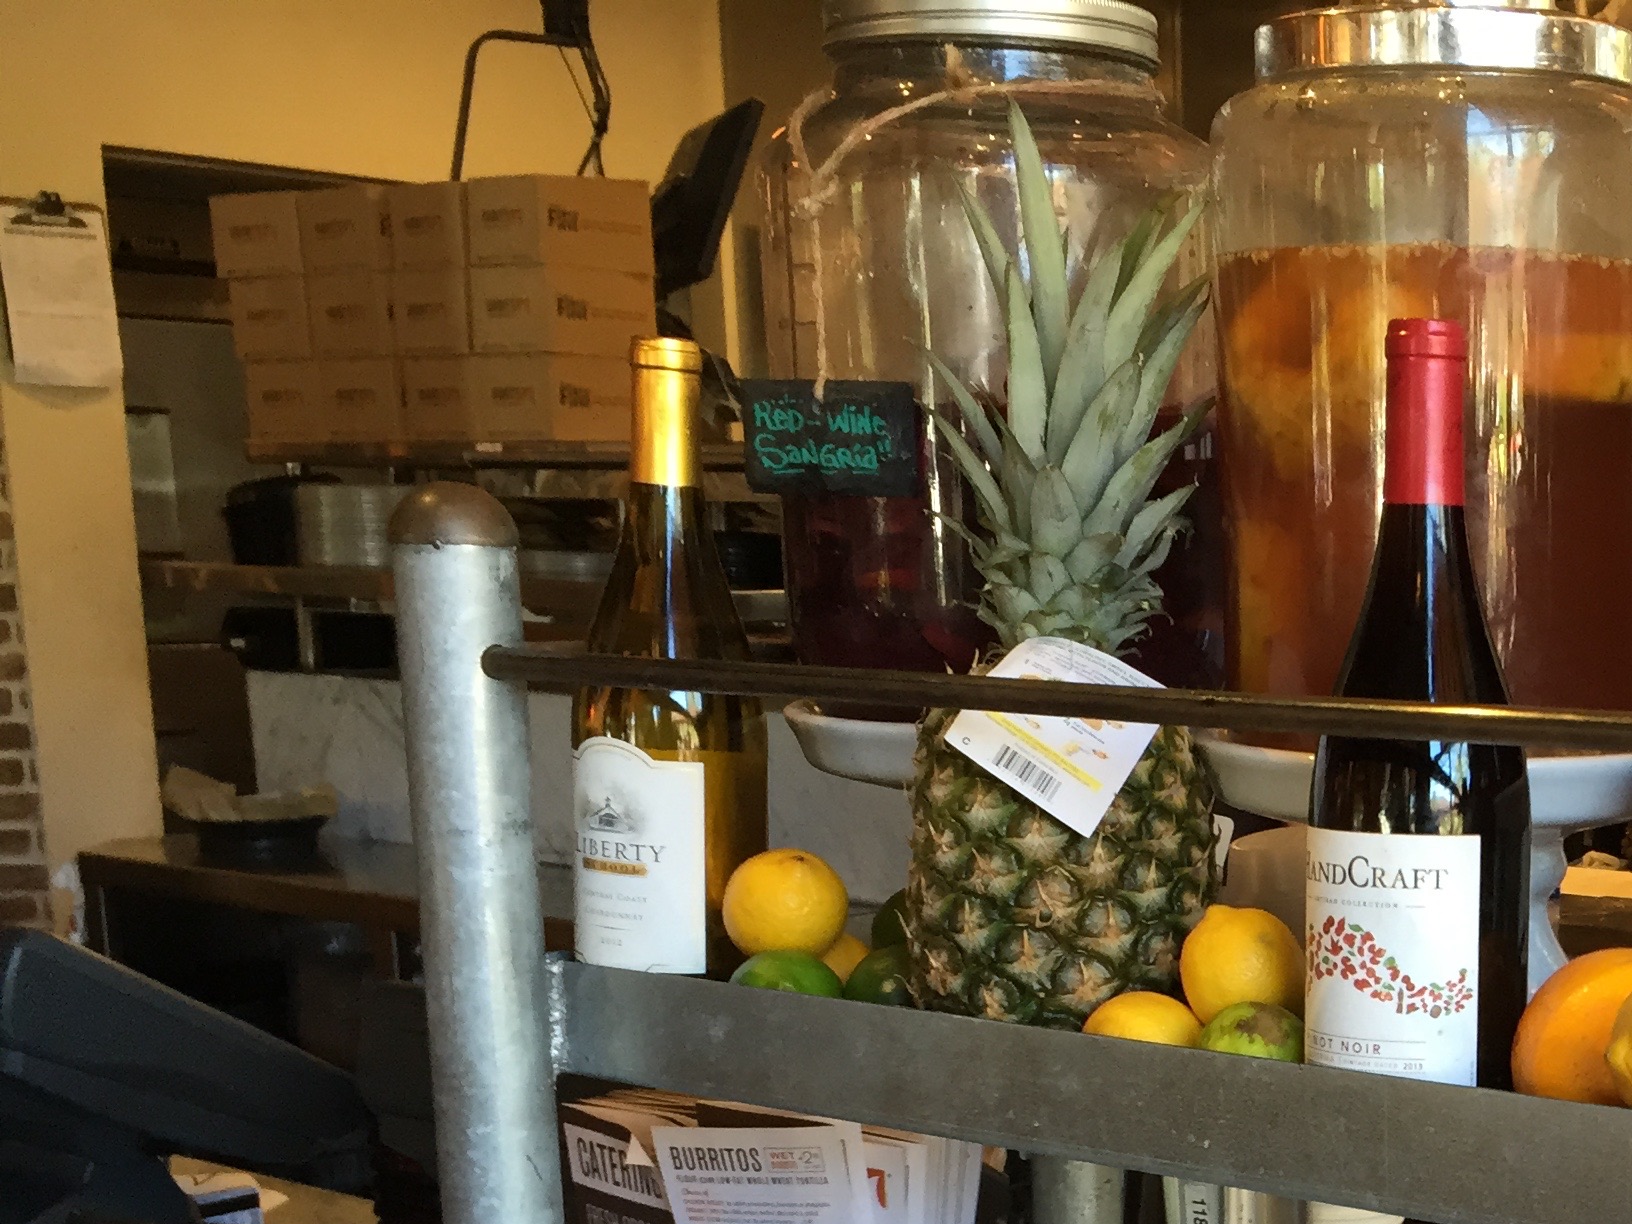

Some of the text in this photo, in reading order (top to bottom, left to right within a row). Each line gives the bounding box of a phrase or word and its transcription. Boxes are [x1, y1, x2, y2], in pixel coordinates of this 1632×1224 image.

[1340, 1041, 1381, 1056] NOIR
[576, 1136, 663, 1199] CATERING
[669, 1146, 763, 1173] BURRITOS
